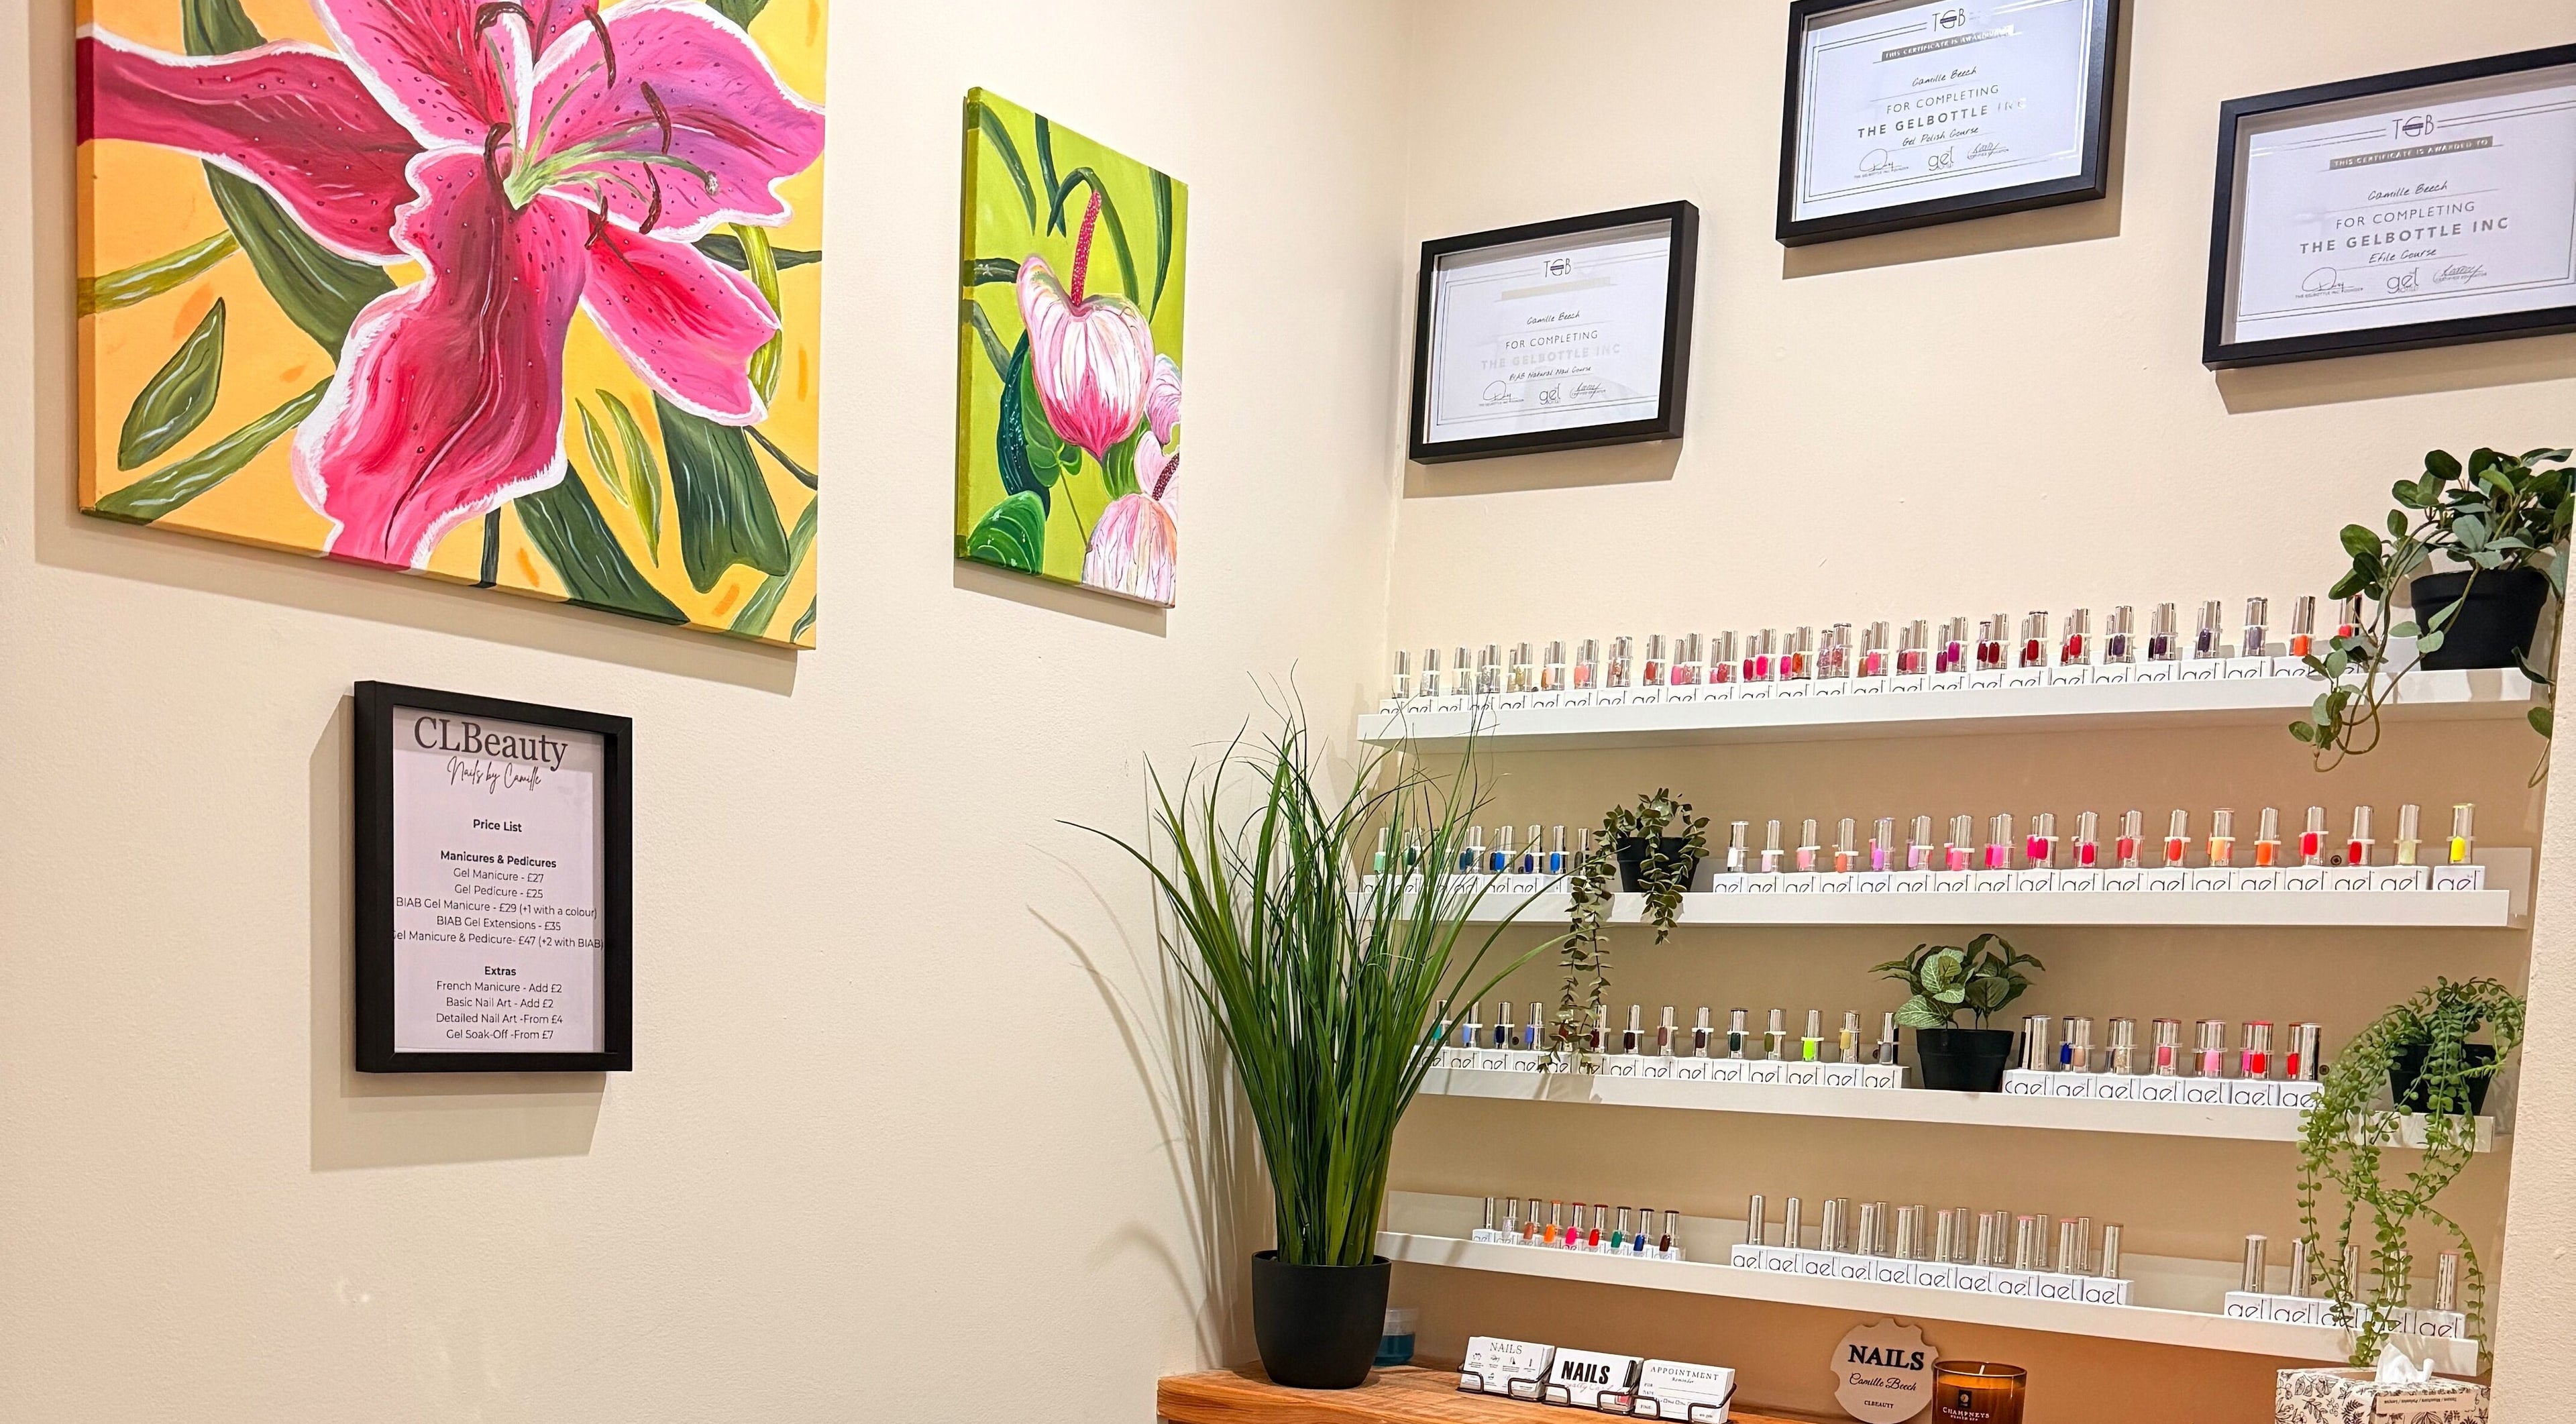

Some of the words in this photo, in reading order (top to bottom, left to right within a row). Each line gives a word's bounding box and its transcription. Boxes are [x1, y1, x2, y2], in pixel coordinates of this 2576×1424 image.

[1913, 74, 1945, 87] Camille
[1950, 66, 1977, 78] Beech
[1887, 101, 1910, 114] FOR
[1917, 85, 1998, 108] COMPLETING
[1858, 124, 1886, 138] THE
[1896, 105, 1988, 131] GELBOTTLE
[1921, 131, 1945, 143] Polish
[1949, 126, 1979, 138] Course
[1928, 146, 1954, 171] gel
[2334, 159, 2353, 167] THIS
[2357, 150, 2412, 164] CERTIFICATE
[2428, 141, 2472, 154] AWARDED
[2367, 187, 2409, 201] Camille
[2415, 180, 2447, 194] Beech
[2336, 217, 2365, 229] FOR
[2373, 201, 2475, 224] COMPLETING
[2300, 240, 2335, 254] THE
[2347, 223, 2461, 249] GELBOTTLE
[2473, 217, 2508, 233] INC
[2400, 248, 2436, 260] Course
[2387, 268, 2418, 294] gel
[1527, 315, 1555, 325] Camille
[1506, 340, 1525, 349] FOR
[1530, 331, 1598, 347] COMPLETING
[1482, 358, 1506, 370] THE
[1513, 347, 1589, 366] GELBOTTLE
[1597, 344, 1621, 357] INC
[1527, 370, 1553, 379] Natural
[1572, 366, 1591, 374] Course
[1539, 383, 1561, 405] gel
[414, 716, 568, 771] CLBeauty
[447, 756, 484, 786] Nails
[485, 761, 501, 794] by
[504, 763, 541, 791] Camille
[473, 819, 500, 830] Price
[503, 820, 523, 832] List
[440, 851, 494, 864] Manicures
[497, 855, 504, 865] &
[507, 855, 557, 868] Pedicures
[453, 868, 470, 878] Gel
[473, 870, 519, 881] Manicure
[527, 873, 544, 883] £27
[455, 884, 471, 894] Gel
[474, 885, 517, 897] Pedicure
[527, 889, 543, 899] £25
[396, 897, 421, 908] BIAB
[424, 899, 441, 909] Gel
[444, 900, 490, 912] Manicure
[499, 903, 517, 913] £29
[519, 903, 531, 916] (+1
[533, 906, 555, 916] with
[565, 908, 598, 920] colour)
[437, 916, 462, 926] BIAB
[464, 917, 481, 927] Gel
[484, 918, 536, 930] Extensions
[545, 922, 561, 931] £35
[409, 931, 456, 942] Manicure
[459, 932, 466, 942] &
[468, 933, 516, 944] Pedicure-
[519, 936, 535, 946] £47
[538, 936, 552, 948] (+2
[554, 938, 576, 948] with
[578, 939, 604, 950] BIAB)
[484, 967, 517, 977] Extras
[437, 981, 471, 991] French
[474, 981, 520, 992] Manicure
[529, 983, 548, 993] Add
[551, 984, 562, 993] £2
[446, 997, 472, 1007] Basic
[476, 997, 494, 1007] Nail
[496, 998, 511, 1007] Art
[520, 999, 540, 1008] Add
[543, 999, 553, 1008] £2
[436, 1013, 478, 1023] Detailed
[481, 1014, 500, 1023] Nail
[502, 1014, 517, 1024] Art
[551, 1015, 564, 1024] £4
[446, 1030, 463, 1039] Gel
[466, 1029, 508, 1039] Soak-Off
[542, 1030, 553, 1040] £7
[1490, 1342, 1523, 1355] NAILS
[1847, 1344, 1925, 1371] NAILS
[1561, 1361, 1610, 1384] NAILS
[1650, 1366, 1719, 1381] APPOINTMENT
[1849, 1372, 1884, 1388] Camille
[1885, 1377, 1917, 1392] Beech
[1942, 1407, 1990, 1419] CHAMPNEYS
